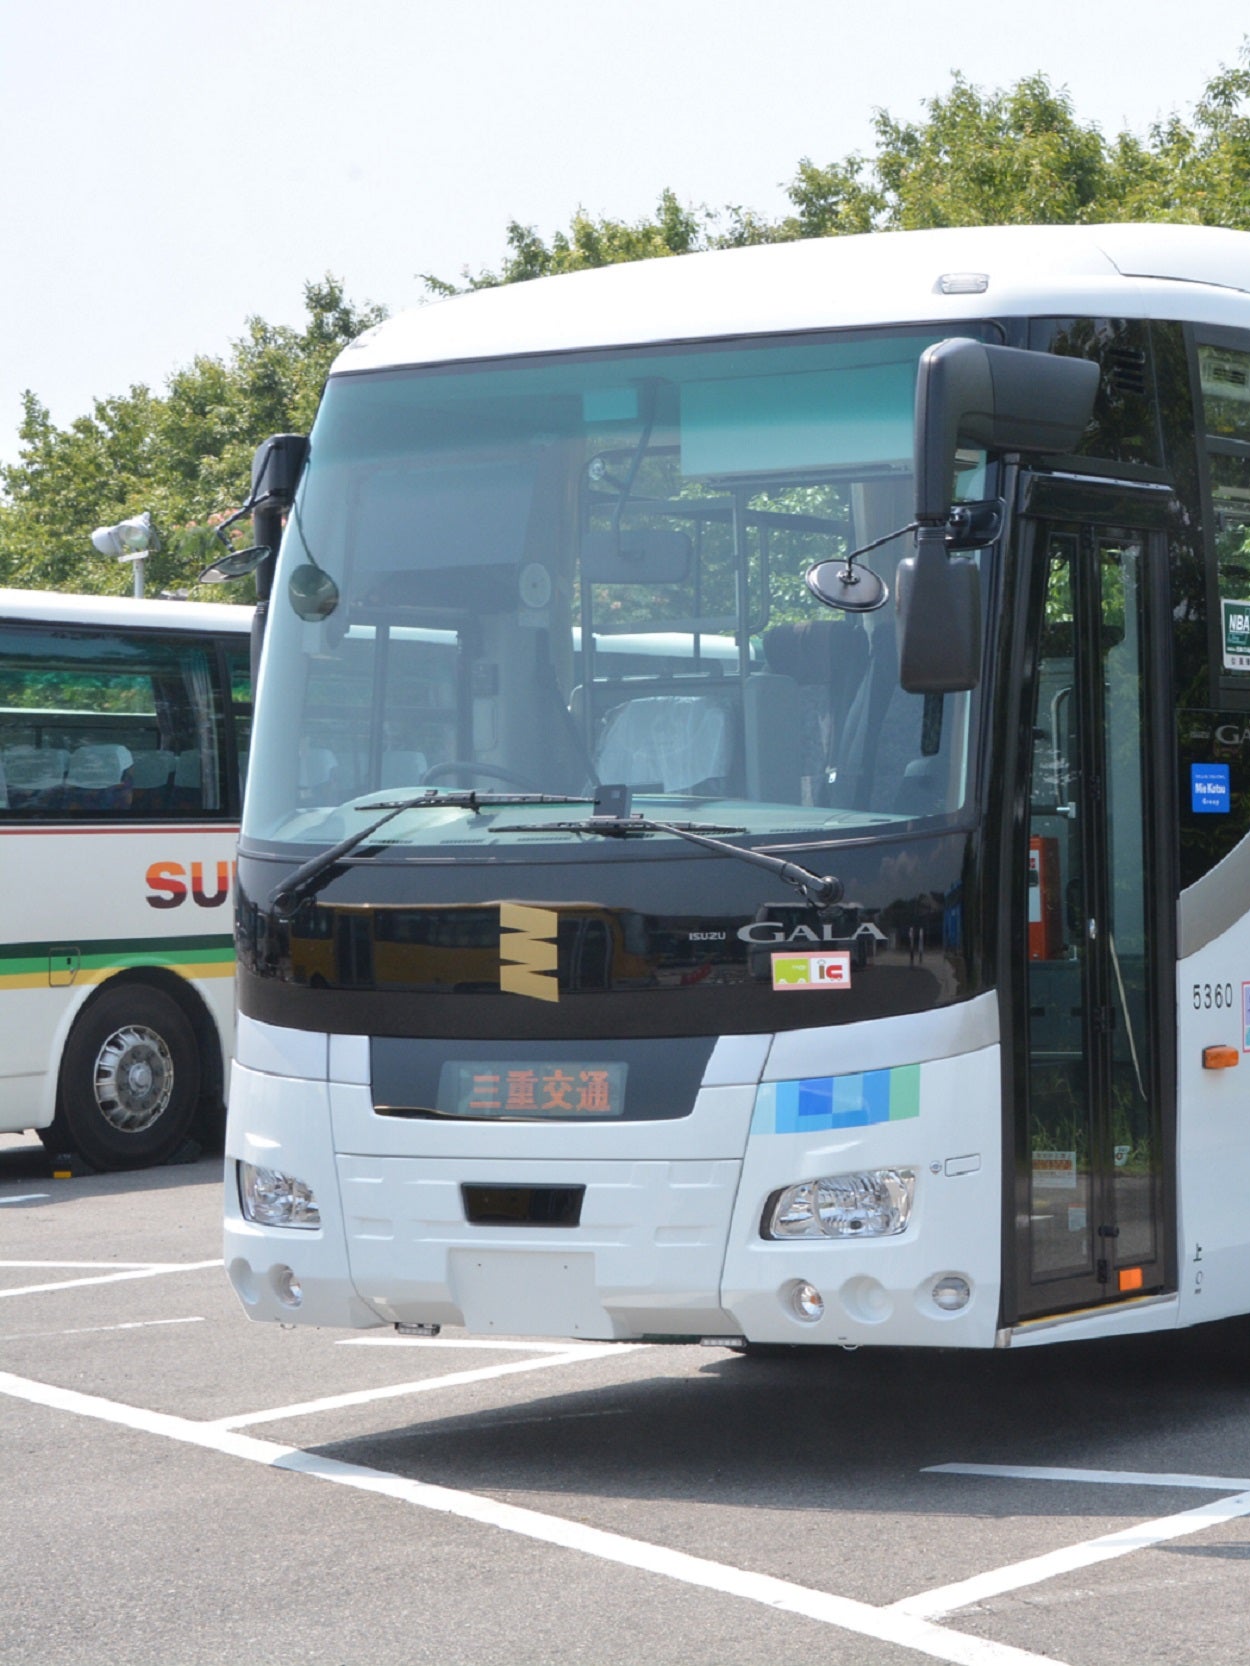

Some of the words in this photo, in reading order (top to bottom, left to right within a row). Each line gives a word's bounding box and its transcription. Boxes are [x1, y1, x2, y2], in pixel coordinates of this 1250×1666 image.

[1229, 614, 1250, 632] NBA
[145, 861, 237, 909] SU
[689, 931, 727, 941] ISUZU
[737, 921, 889, 944] GALA
[1193, 983, 1233, 1010] 5360
[469, 1069, 611, 1112] 三重交通
